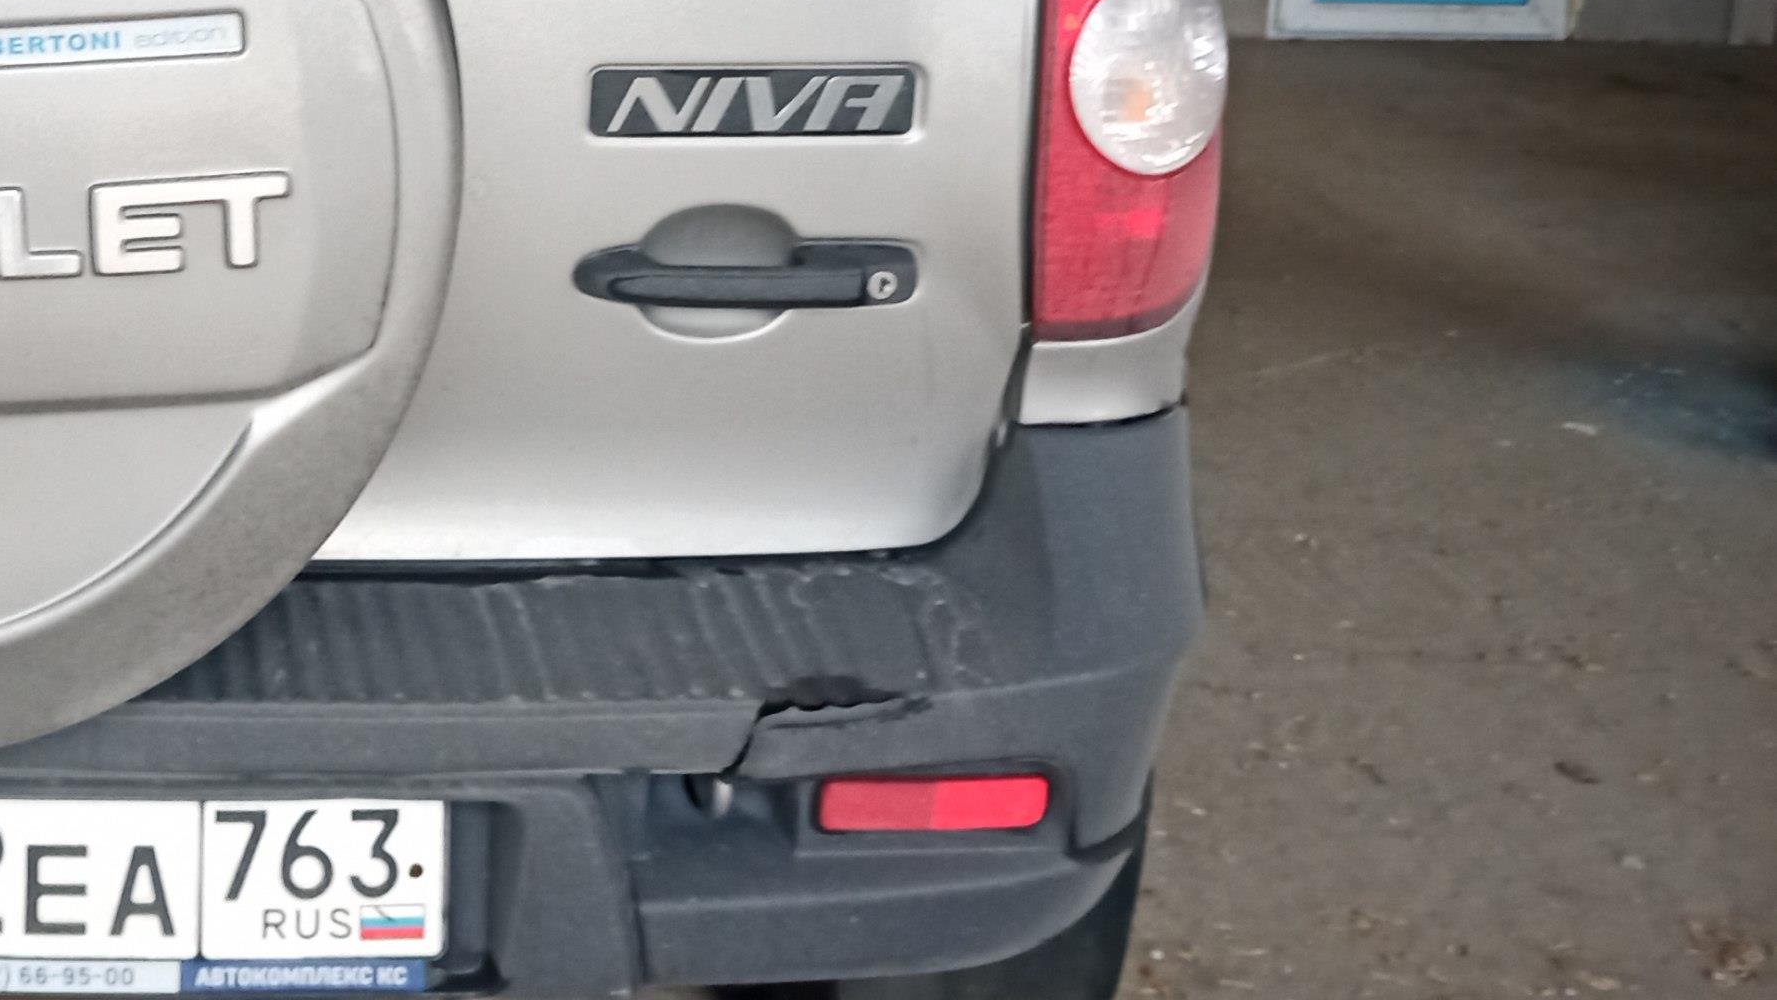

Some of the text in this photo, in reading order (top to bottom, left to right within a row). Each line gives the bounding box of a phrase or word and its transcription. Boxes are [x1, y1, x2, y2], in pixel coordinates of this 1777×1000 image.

[606, 75, 905, 132] NIVA
[214, 808, 401, 902] 763
[262, 908, 352, 940] RUS
[20, 965, 135, 986] 66-95-00
[194, 964, 374, 986] АВТОКОМПЛЕКС
